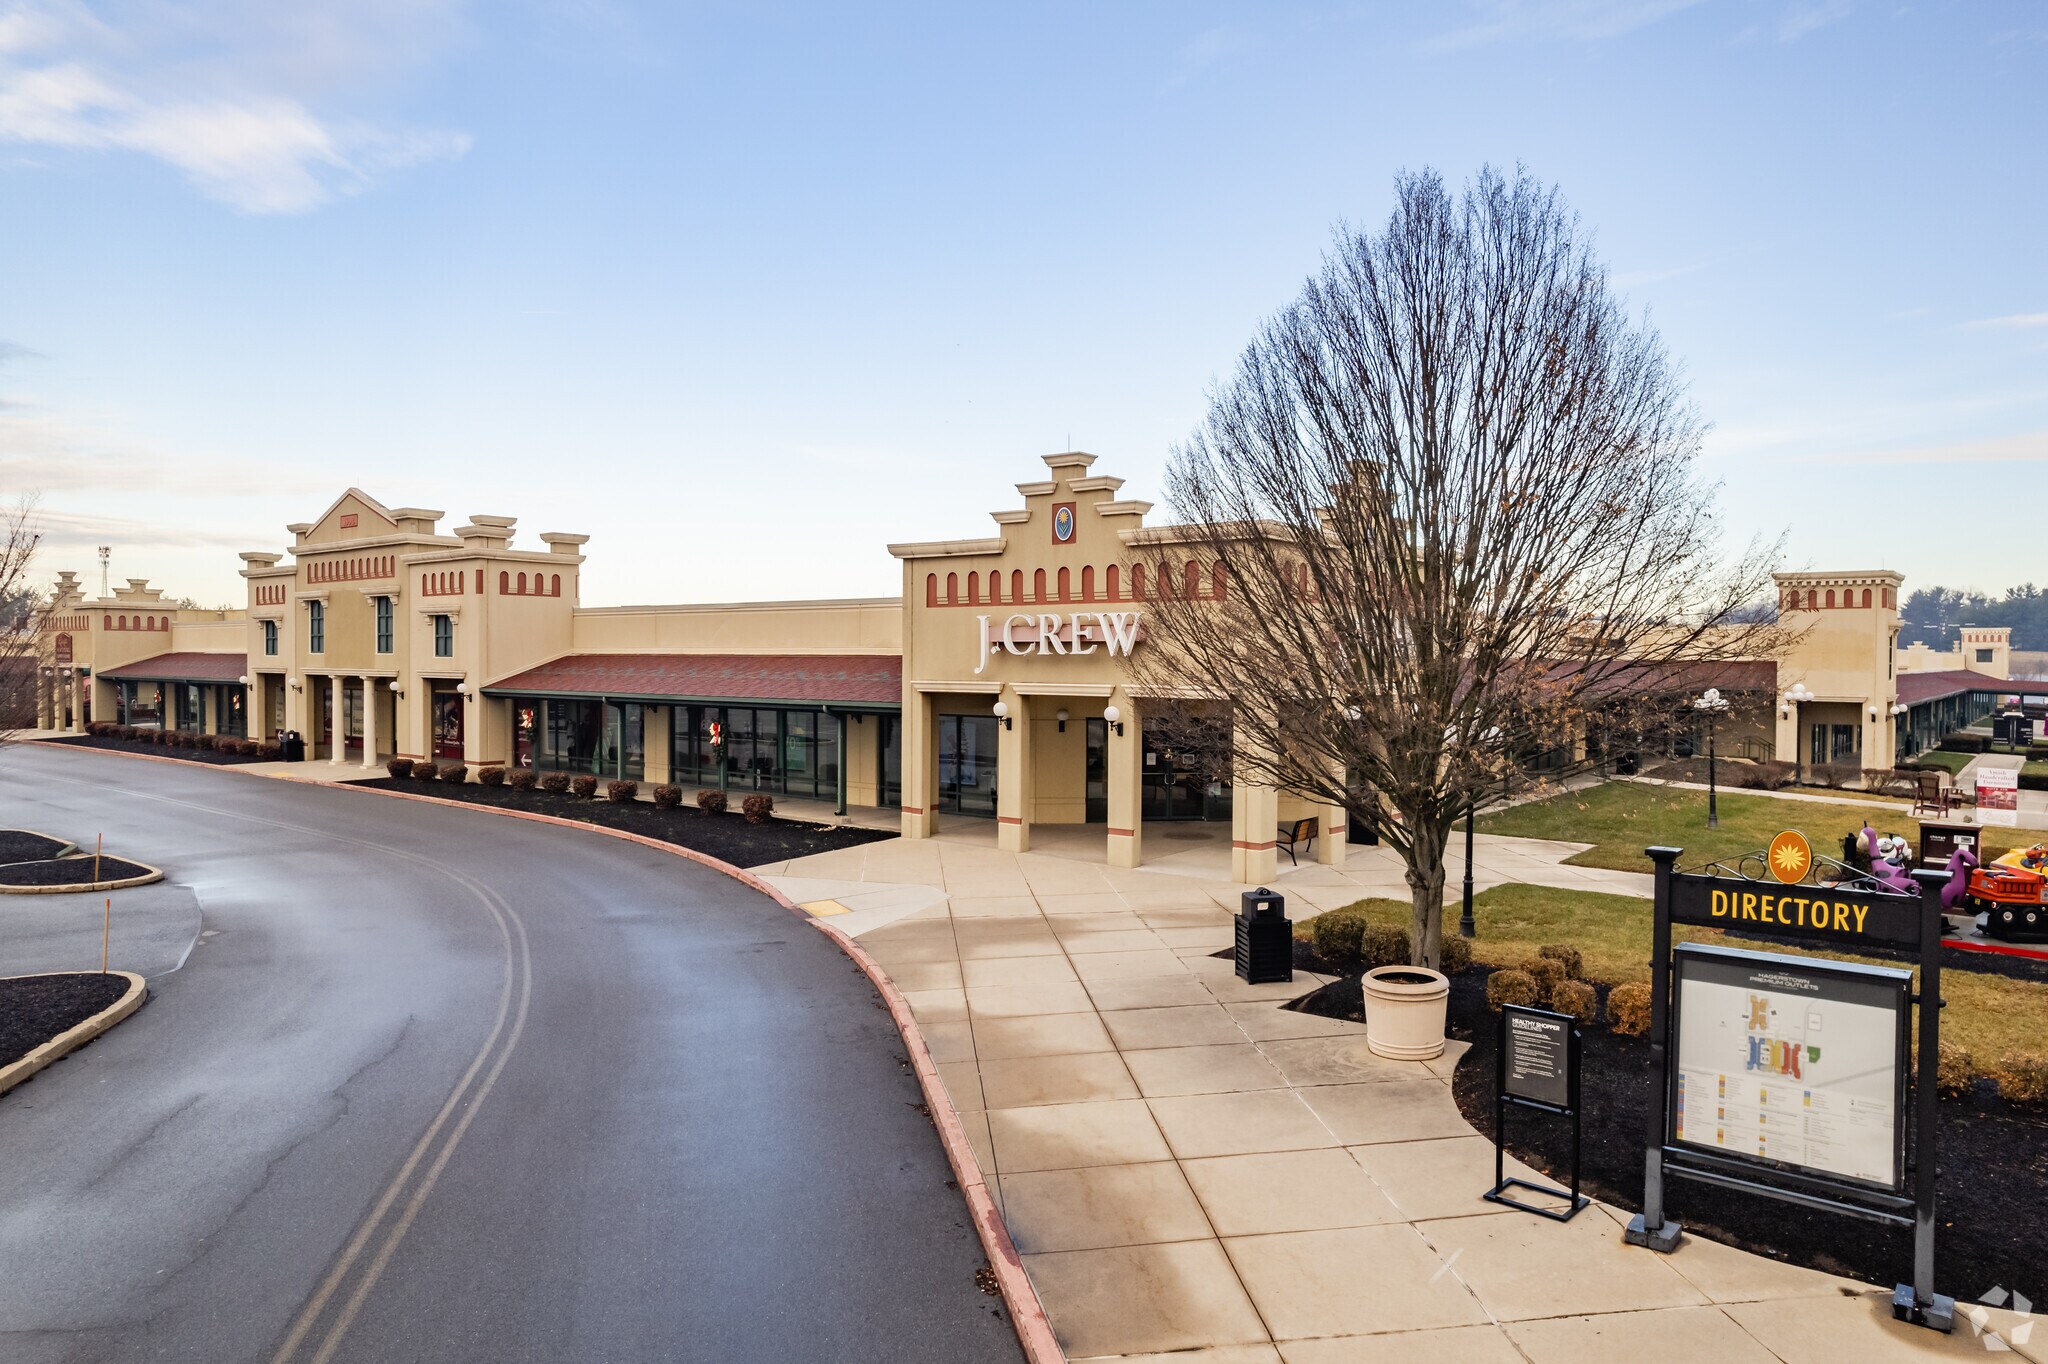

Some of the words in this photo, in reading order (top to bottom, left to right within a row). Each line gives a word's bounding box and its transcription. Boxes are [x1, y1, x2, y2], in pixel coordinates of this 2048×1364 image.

[1711, 889, 1869, 933] DIRECTORY
[1749, 976, 1784, 985] PREMIUM
[1784, 981, 1819, 991] OUTLETS
[1758, 973, 1810, 984] HAGERSTOWN
[1512, 1018, 1536, 1026] HEALTHY
[1536, 1022, 1560, 1031] SHOPPER
